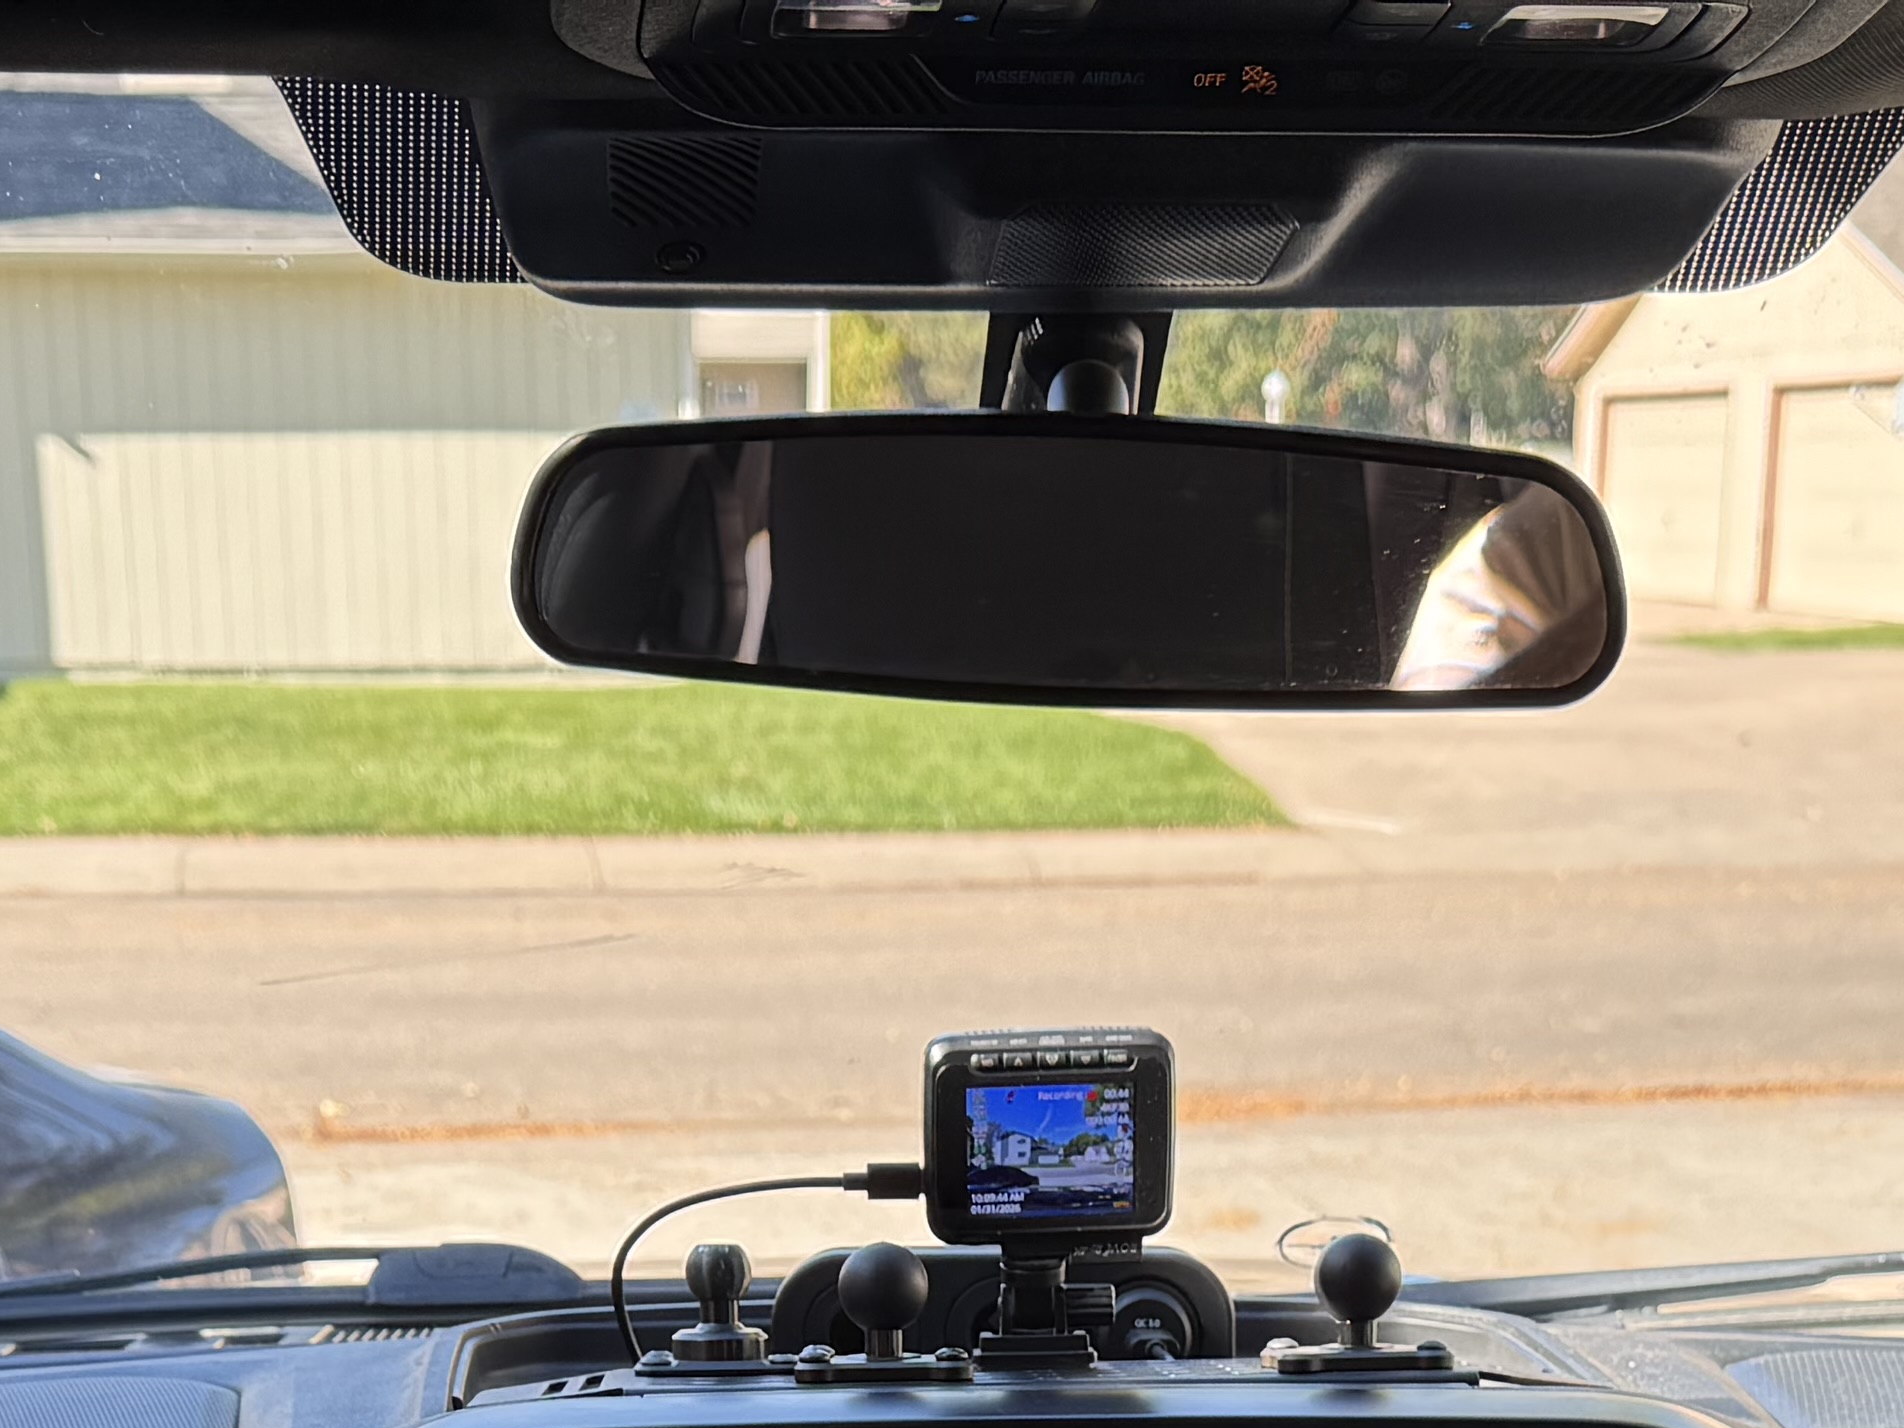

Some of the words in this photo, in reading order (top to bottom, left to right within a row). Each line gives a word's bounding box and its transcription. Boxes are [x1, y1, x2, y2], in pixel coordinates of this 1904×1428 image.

[976, 69, 1075, 86] PASSENGER
[1081, 71, 1146, 87] AIRBAG
[1193, 72, 1228, 88] OFF
